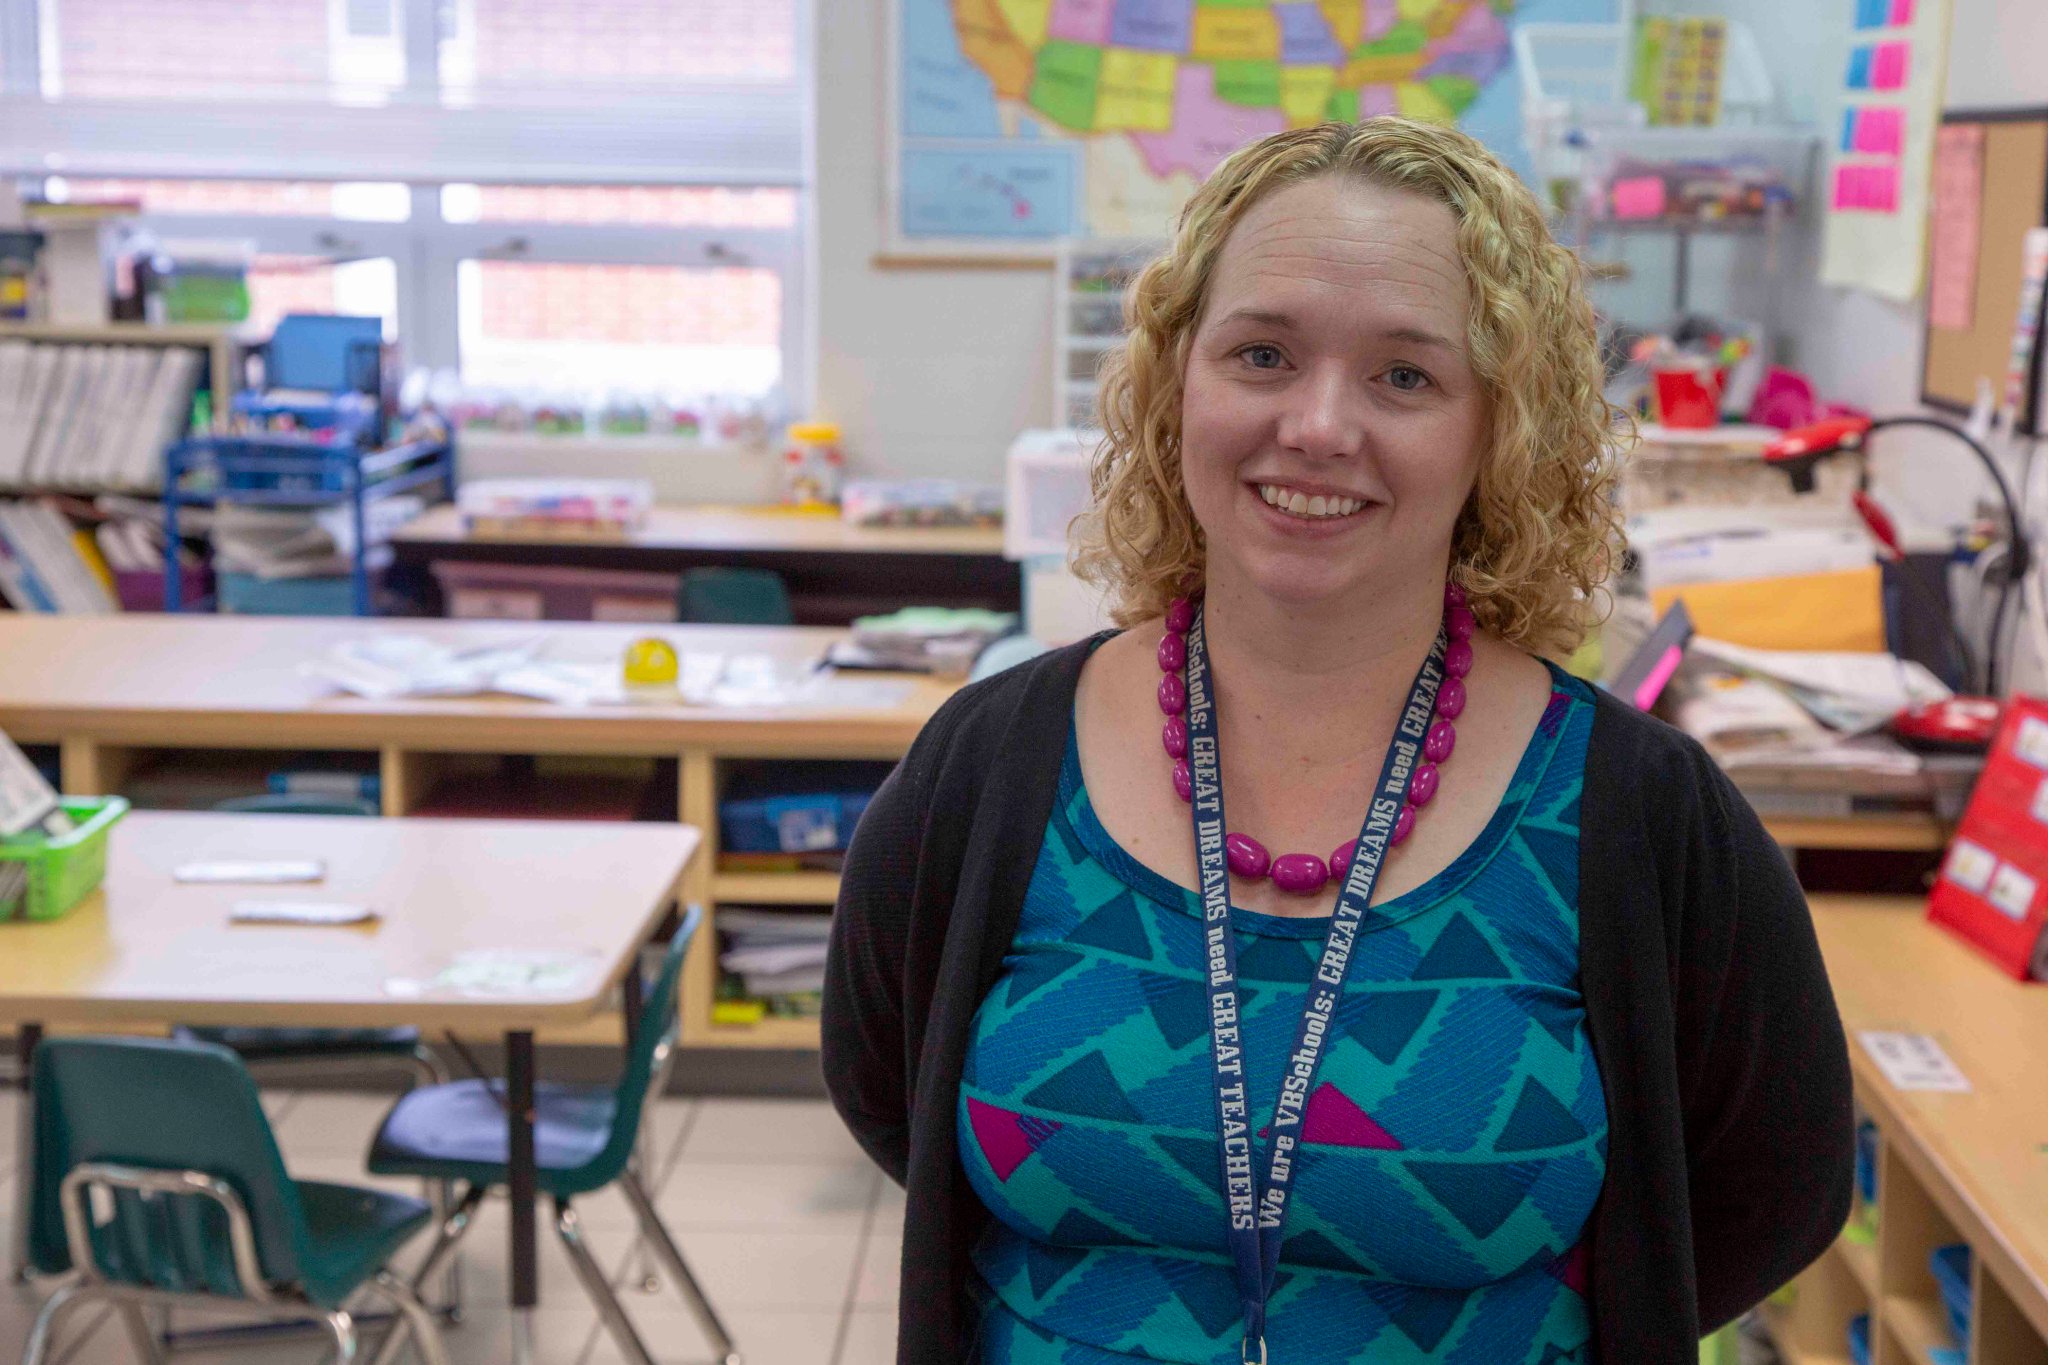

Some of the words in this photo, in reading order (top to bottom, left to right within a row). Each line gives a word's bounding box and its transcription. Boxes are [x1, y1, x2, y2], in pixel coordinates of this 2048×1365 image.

[1401, 661, 1442, 738] GREAT
[1192, 736, 1219, 813] GREAT
[1385, 740, 1417, 793] need
[1198, 818, 1227, 921] DREAMS
[1346, 798, 1397, 899] DREAMS
[1208, 926, 1233, 987] need
[1318, 901, 1362, 985] GREAT
[1212, 992, 1241, 1075] GREAT
[1275, 990, 1336, 1127] VBSchools:
[1220, 1082, 1254, 1230] TEACHERS
[1271, 1135, 1294, 1182] are
[1258, 1188, 1285, 1228] We
